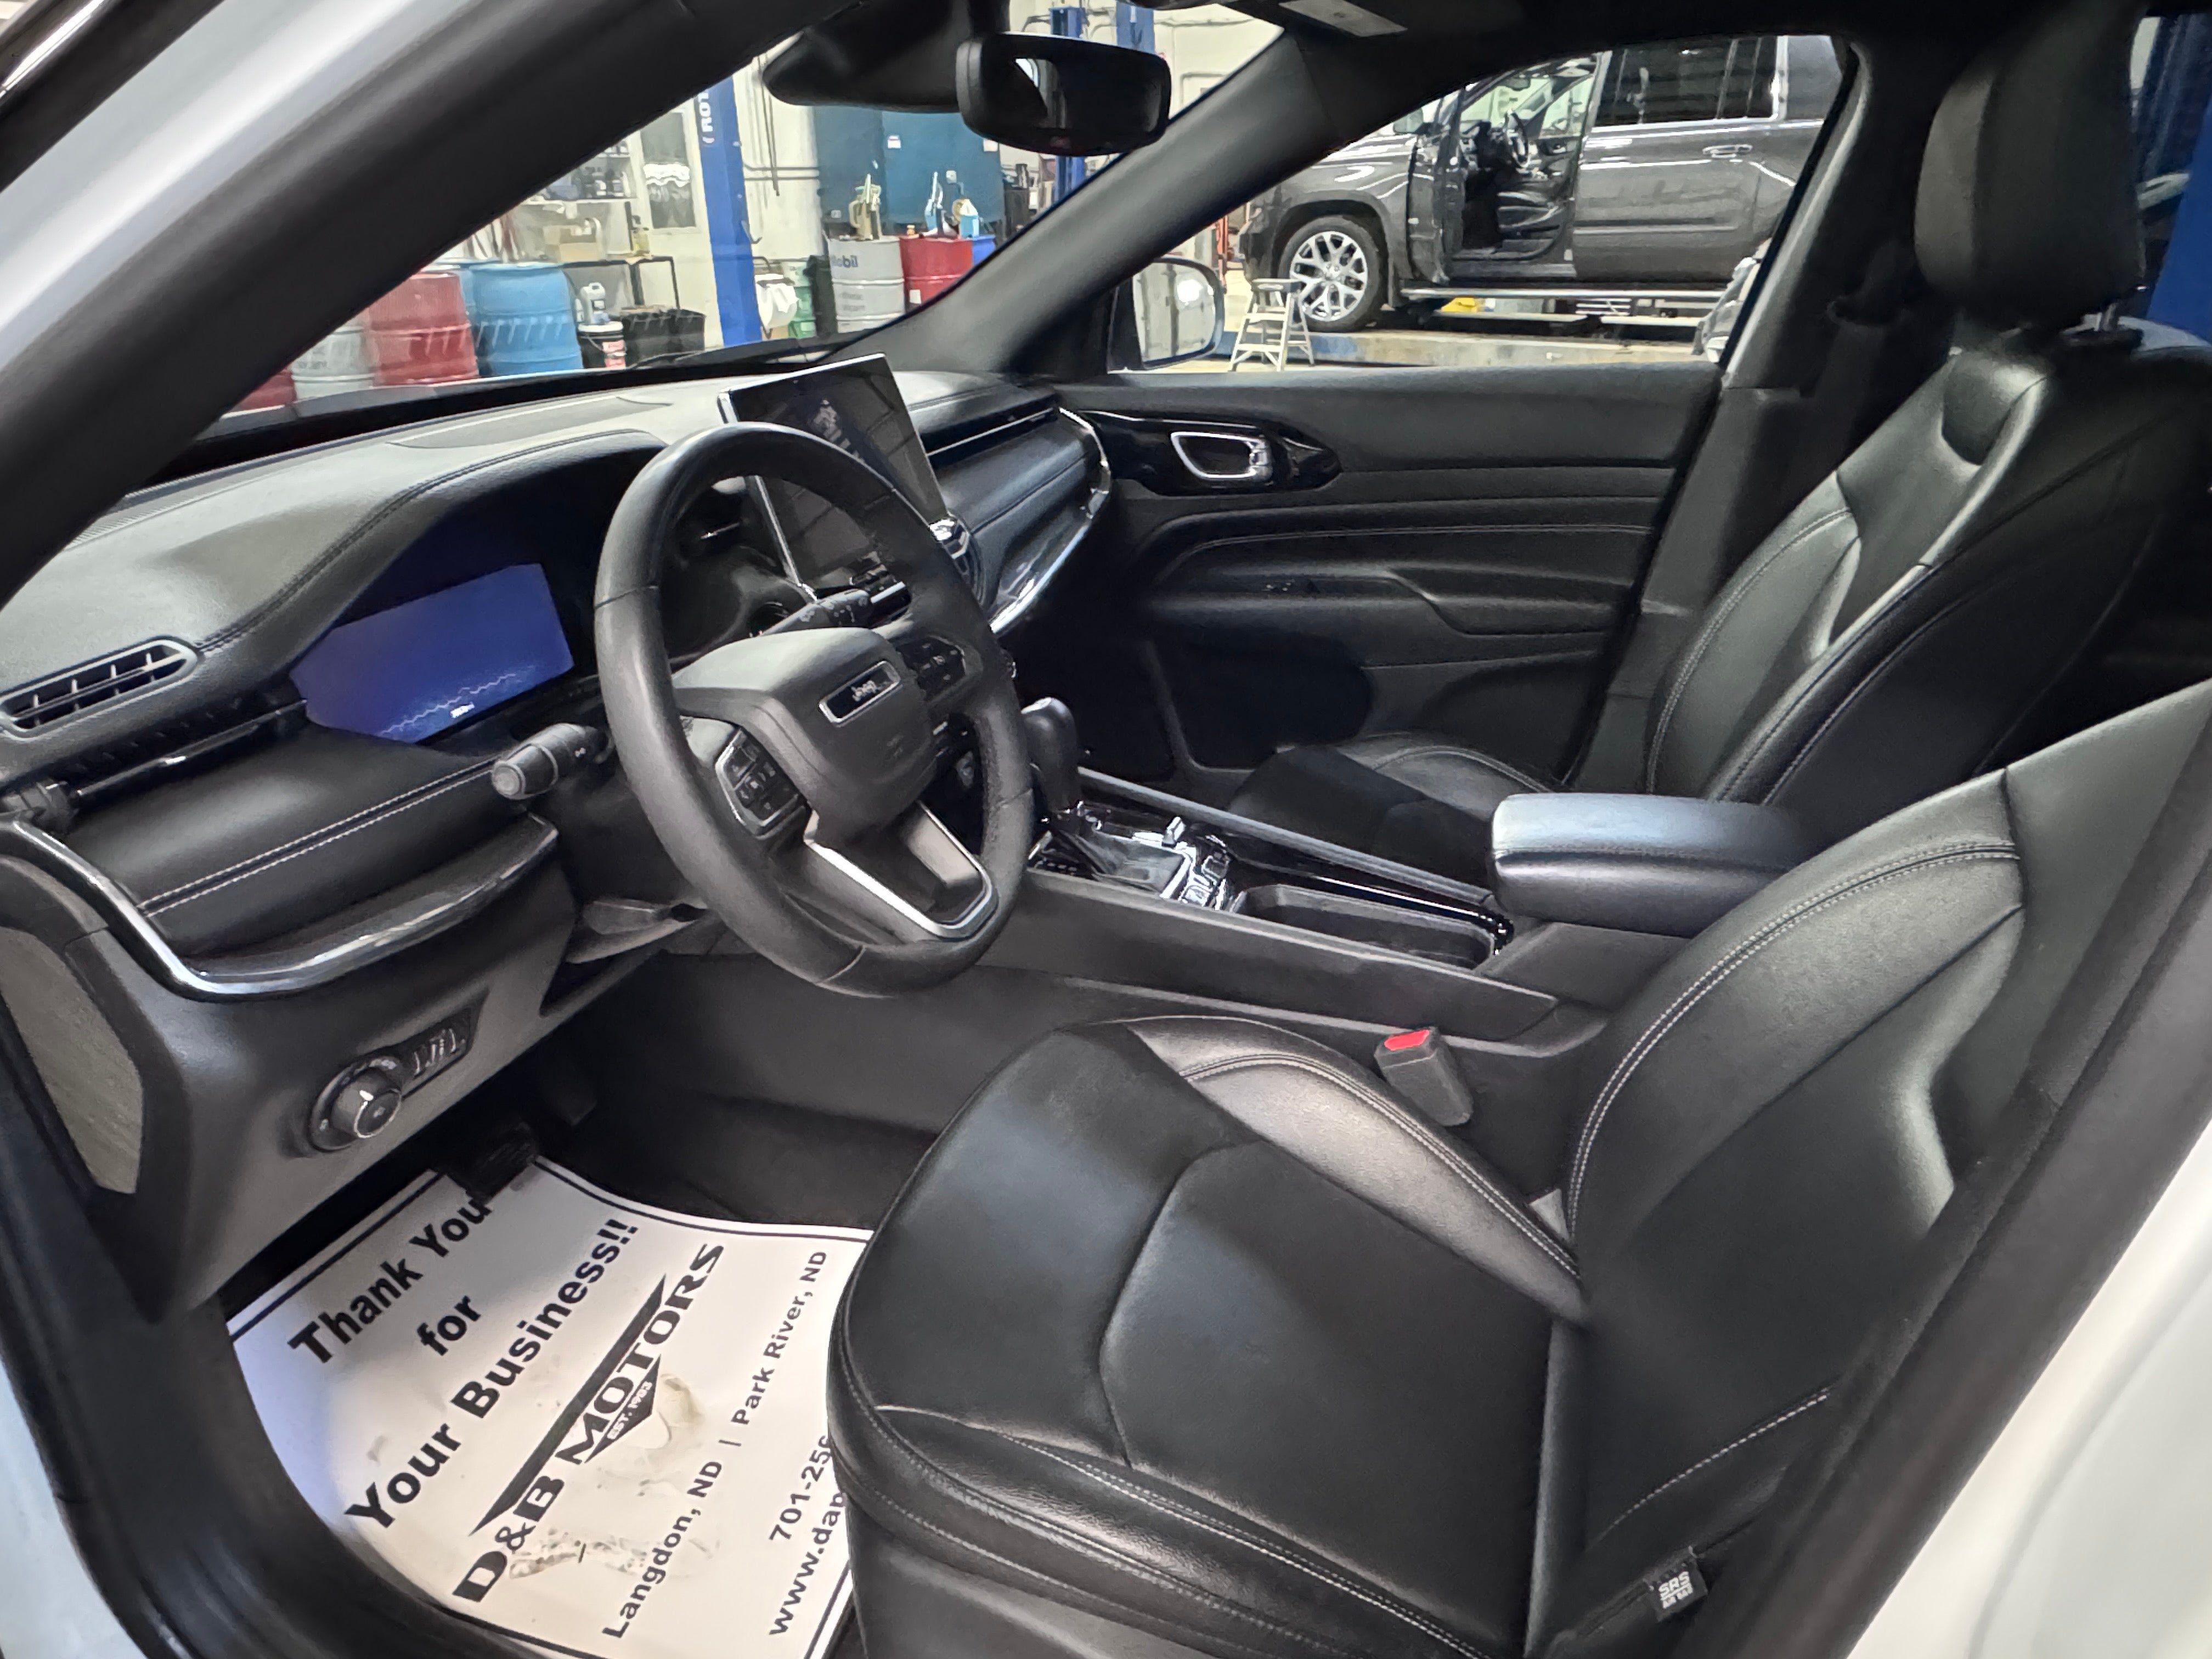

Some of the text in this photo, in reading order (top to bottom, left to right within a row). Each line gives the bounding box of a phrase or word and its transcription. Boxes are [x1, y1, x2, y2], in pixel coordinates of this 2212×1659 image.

[287, 1199, 493, 1364] Thank You
[344, 1219, 639, 1528] Your Business!!
[416, 1295, 481, 1356] for
[452, 1243, 724, 1602] D&B MOTORS
[602, 1507, 702, 1639] Langdon,
[687, 1460, 722, 1498] ND
[731, 1368, 775, 1425] Park
[763, 1289, 814, 1359] River,
[799, 1251, 827, 1283] ND
